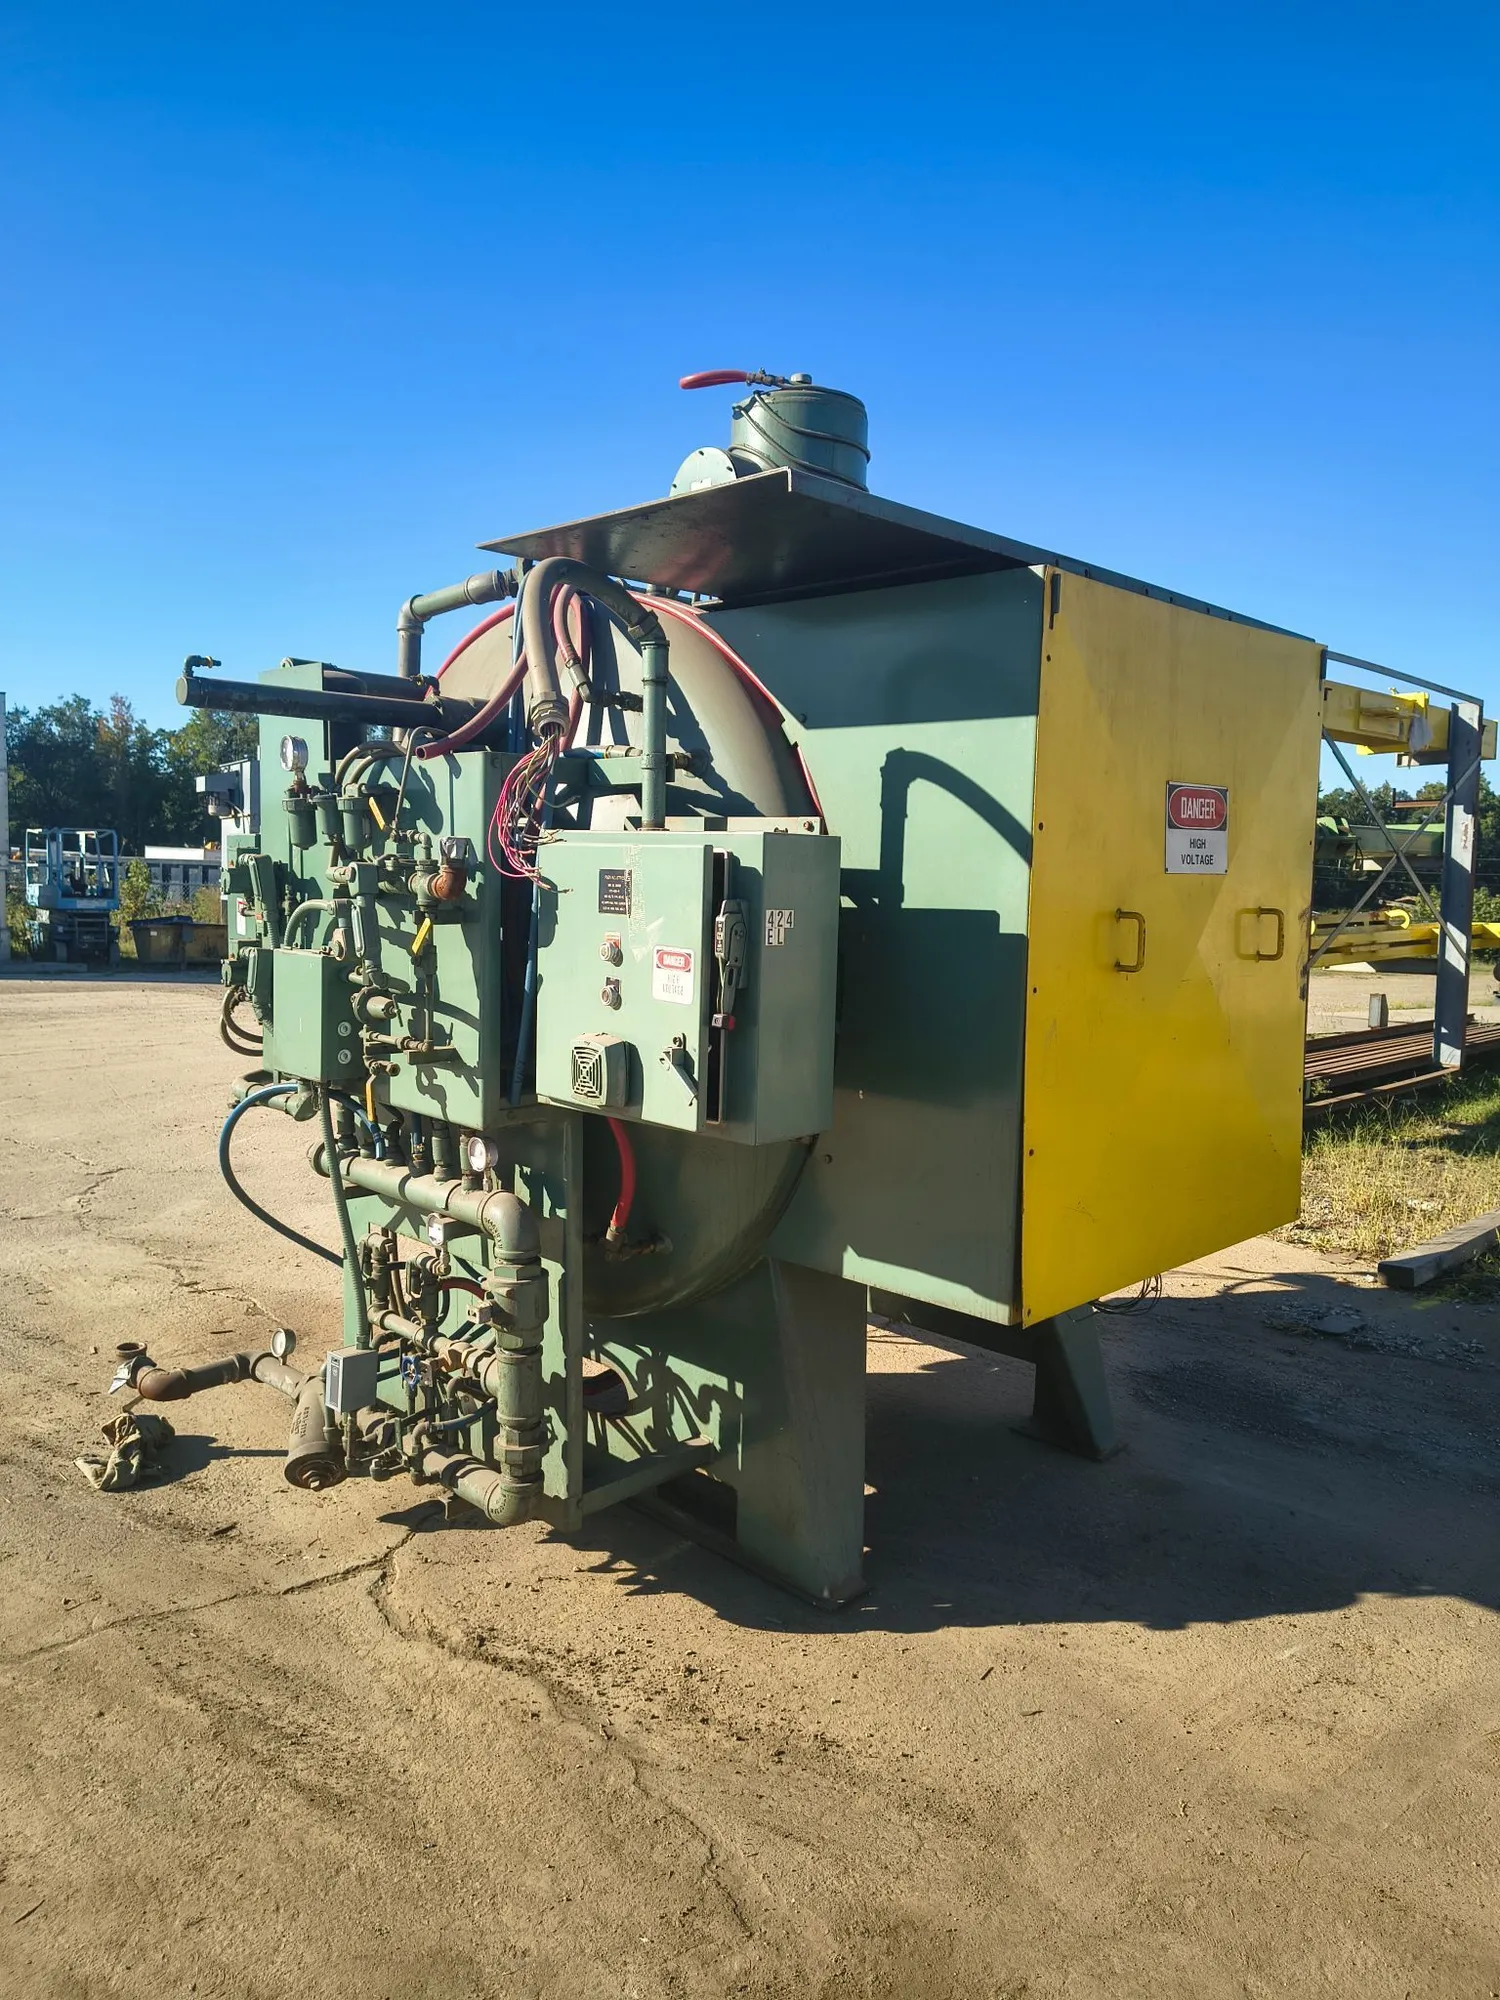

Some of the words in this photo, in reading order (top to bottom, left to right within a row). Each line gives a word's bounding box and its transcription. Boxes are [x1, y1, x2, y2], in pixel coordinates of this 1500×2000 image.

[1180, 796, 1216, 819] DANGER
[1189, 838, 1207, 849] HIGH
[1181, 853, 1214, 865] VOLTAGE
[767, 910, 793, 928] 424
[767, 928, 783, 945] EL
